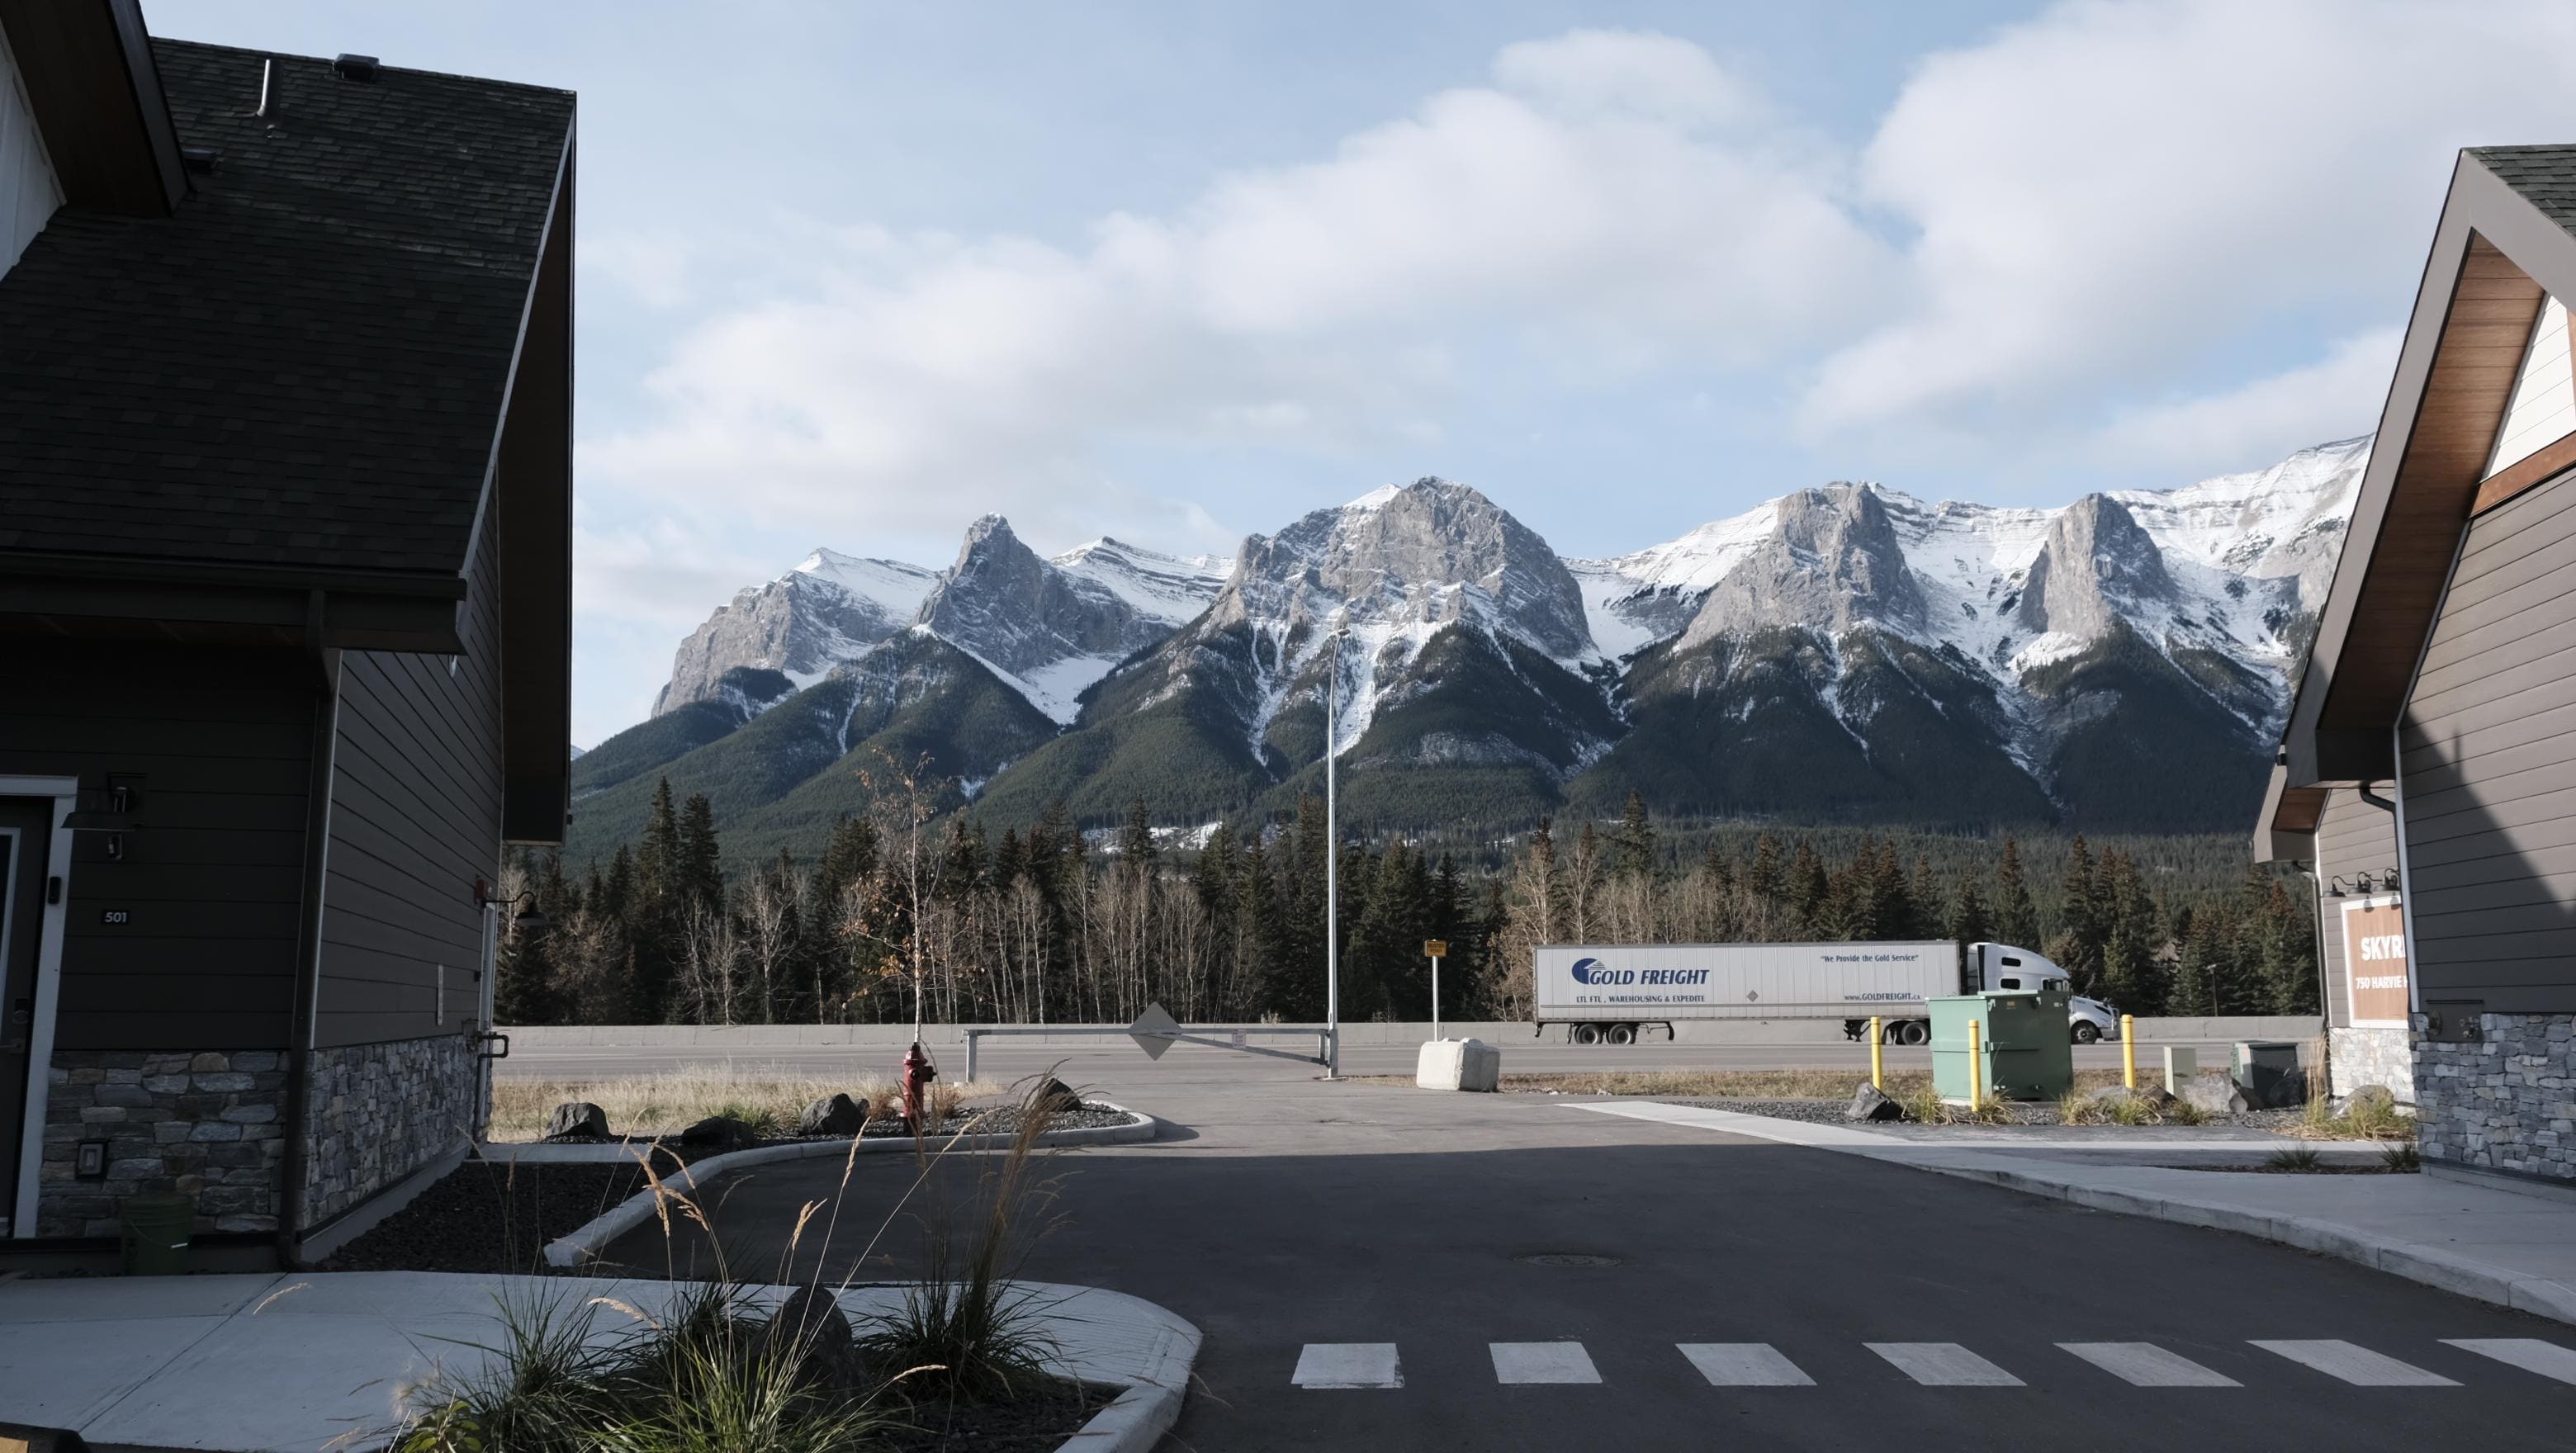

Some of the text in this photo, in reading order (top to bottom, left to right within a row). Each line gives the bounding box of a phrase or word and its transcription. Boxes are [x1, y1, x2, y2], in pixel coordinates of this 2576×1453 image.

[105, 911, 127, 923] 501
[1589, 969, 1710, 985] GOLD FREIGHT
[2356, 977, 2370, 990] 750
[2371, 975, 2403, 989] HARVIE
